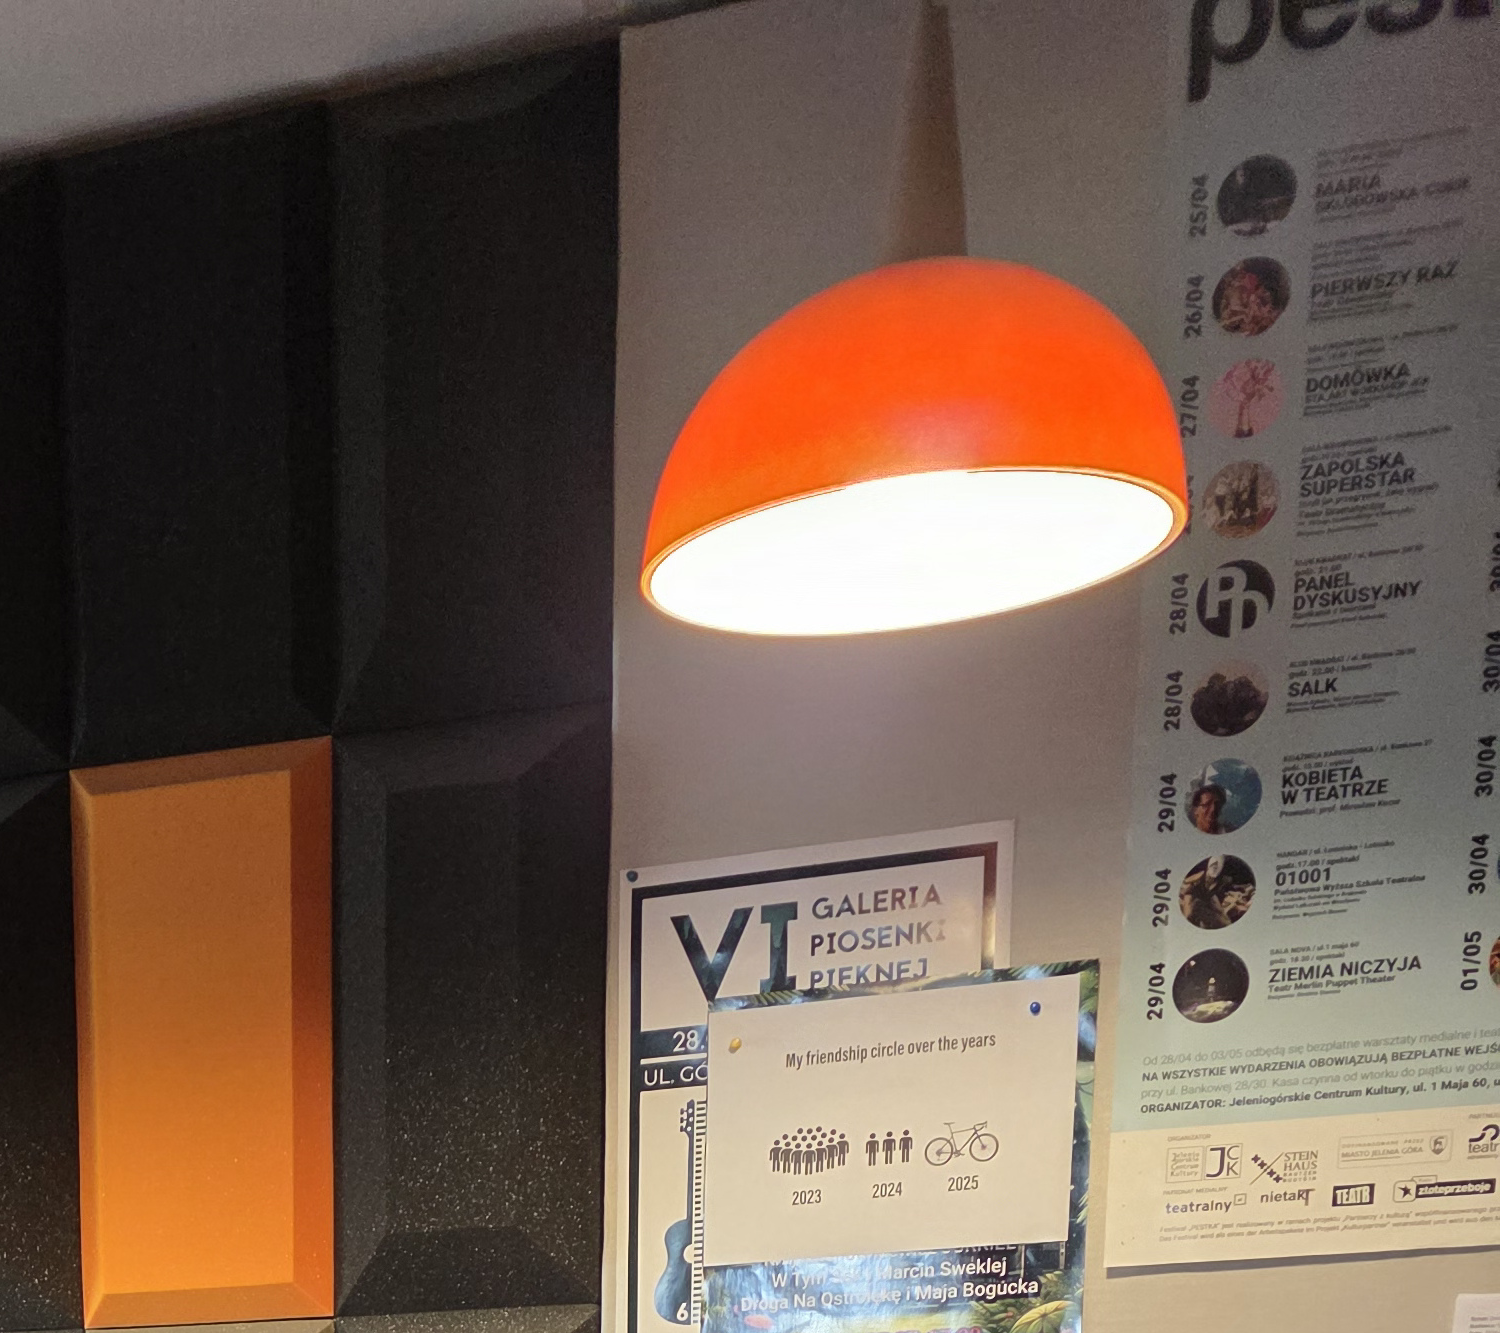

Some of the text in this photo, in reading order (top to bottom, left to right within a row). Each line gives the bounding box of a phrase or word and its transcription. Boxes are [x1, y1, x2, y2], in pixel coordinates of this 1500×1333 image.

[1311, 268, 1412, 299] PIERWSZY
[1181, 374, 1200, 438] 27/04
[1301, 451, 1405, 481] ZAPOLSKA
[1300, 467, 1416, 498] SUPERSTAR
[1293, 580, 1422, 611] DYSKUSYJNY
[1294, 571, 1356, 594] PANEL
[1169, 572, 1189, 636] 28/04
[1164, 670, 1184, 732] 28/04
[1288, 678, 1339, 698] SALK
[1282, 765, 1364, 789] KOBIETA
[1475, 735, 1497, 798] 30/04
[1158, 772, 1178, 834] 29/04
[1281, 778, 1390, 805] W TEATRZE
[1275, 866, 1332, 887] 01001
[1468, 833, 1490, 895] 30/04
[811, 883, 945, 920] GALERIA
[1152, 868, 1172, 929] 29/04
[669, 901, 799, 1003] VI
[810, 918, 947, 957] PIOSENKI
[1268, 963, 1335, 985] ZIEMIA
[1339, 955, 1422, 977] NICZYJA
[1460, 930, 1482, 991] 01/05
[1147, 961, 1167, 1022] 29/04
[1268, 974, 1397, 994] Teatr Merlin Puppet Theater
[672, 1029, 707, 1053] 28.
[786, 1033, 997, 1071] My friendship circle over the years
[643, 1067, 675, 1087] UL.
[1142, 1072, 1159, 1082] NA
[1162, 1066, 1227, 1080] WSZYSTKIE
[1229, 1059, 1307, 1075] WYDARZENIA
[1309, 1052, 1388, 1069] OBOWIĄZUJĄ
[1464, 1041, 1500, 1056] WEJŚ
[1140, 1098, 1227, 1114] ORGANIZATOR:
[1229, 1091, 1311, 1107] Jeleniogórskie
[1314, 1089, 1362, 1101] Centrum
[1365, 1084, 1409, 1097] Kultury,
[1412, 1081, 1427, 1093] ul.
[1440, 1079, 1469, 1092] Maja
[1472, 1077, 1491, 1090] 60,
[1141, 1088, 1164, 1100] przy
[1181, 1081, 1232, 1096] Bankowej
[1272, 1075, 1300, 1087] Kasa
[1302, 1072, 1341, 1086] czynna
[1343, 1071, 1358, 1082] od
[1360, 1069, 1399, 1081] wtorku
[1400, 1066, 1416, 1077] do
[1283, 1161, 1318, 1172] HAUS
[1284, 1150, 1319, 1162] STEIN
[792, 1174, 979, 1206] 2023 2024 2025
[1335, 1185, 1371, 1206] TEATR
[1165, 1200, 1233, 1214] teatralny
[771, 1272, 787, 1288] W
[877, 1261, 936, 1281] Marcin
[939, 1256, 1008, 1279] Sweklej
[740, 1294, 790, 1314] Droga
[793, 1292, 817, 1309] Na
[915, 1281, 958, 1304] Maja
[961, 1277, 1040, 1301] Bogucka
[675, 1302, 689, 1322] 6
